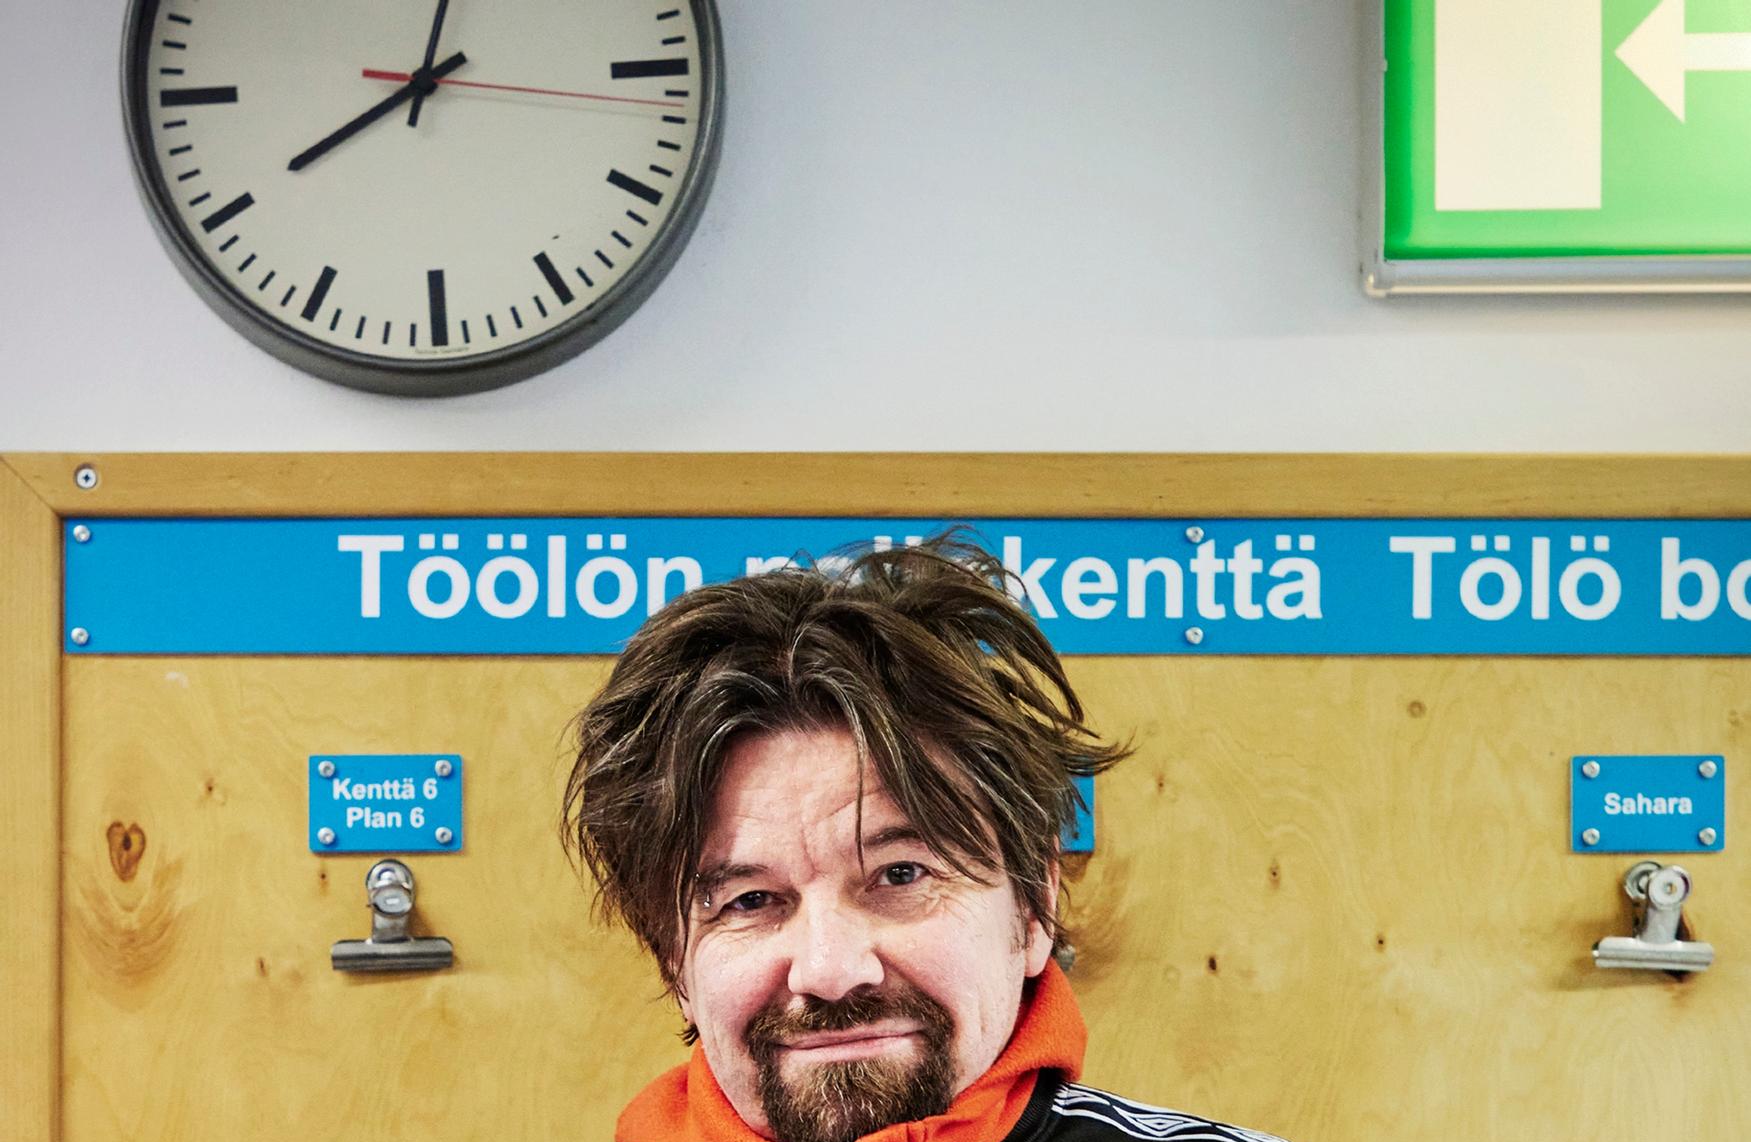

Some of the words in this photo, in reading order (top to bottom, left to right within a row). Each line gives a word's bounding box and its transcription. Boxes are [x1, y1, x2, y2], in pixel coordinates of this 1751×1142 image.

[337, 534, 703, 620] Töölön
[1389, 535, 1622, 620] Tölö
[332, 778, 415, 800] Kenttä
[423, 778, 438, 800] 6
[1604, 792, 1692, 815] Sahara
[346, 806, 402, 828] Plan
[410, 807, 425, 828] 6
